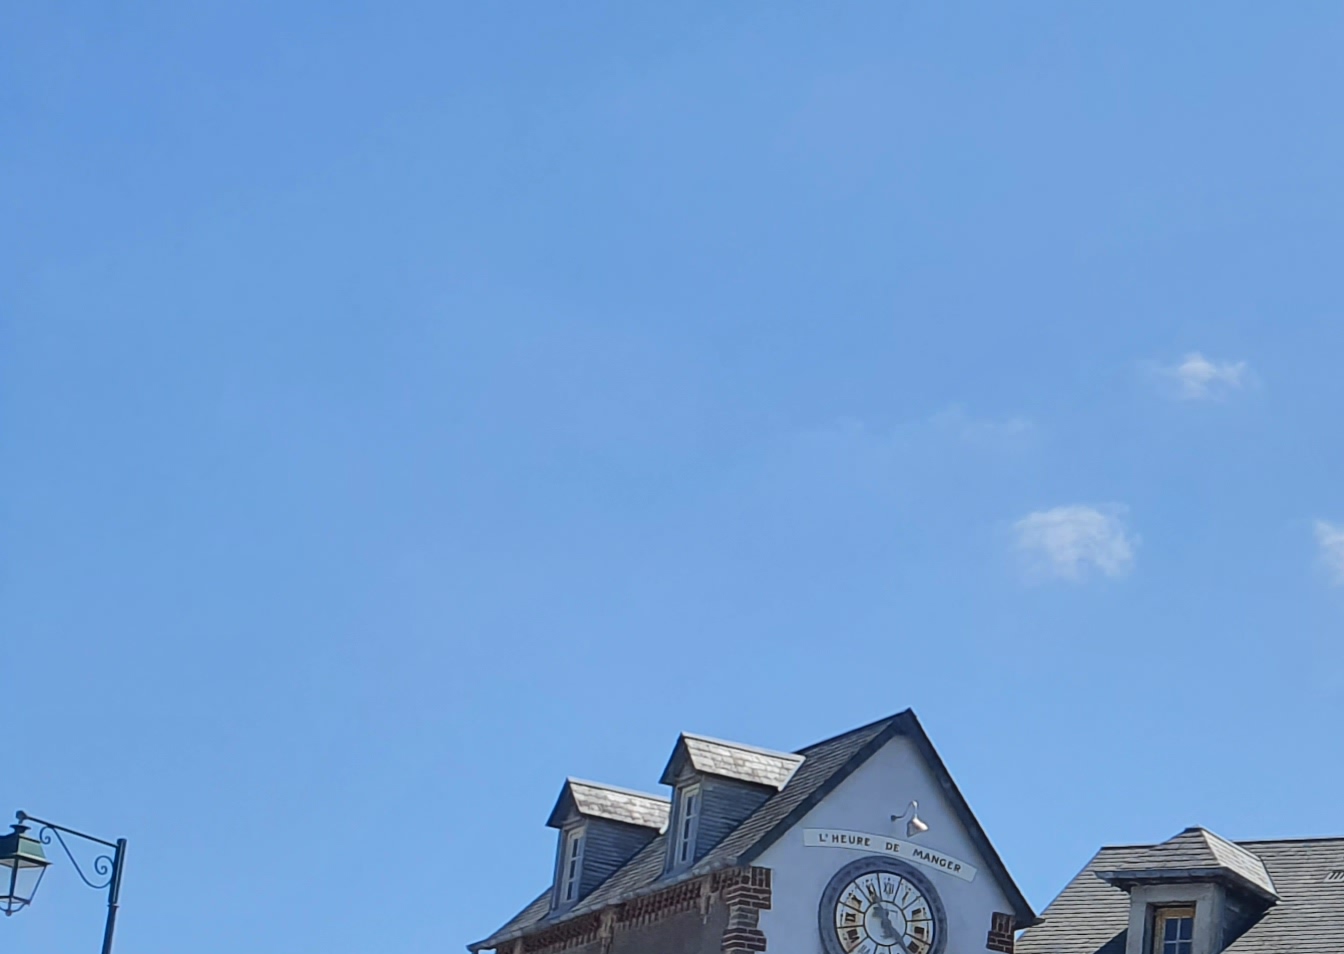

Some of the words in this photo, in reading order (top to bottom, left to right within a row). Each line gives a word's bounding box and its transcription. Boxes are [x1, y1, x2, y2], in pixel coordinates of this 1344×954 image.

[819, 833, 870, 847] L'HEURE
[885, 842, 899, 852] DE
[912, 848, 962, 873] MANGER
